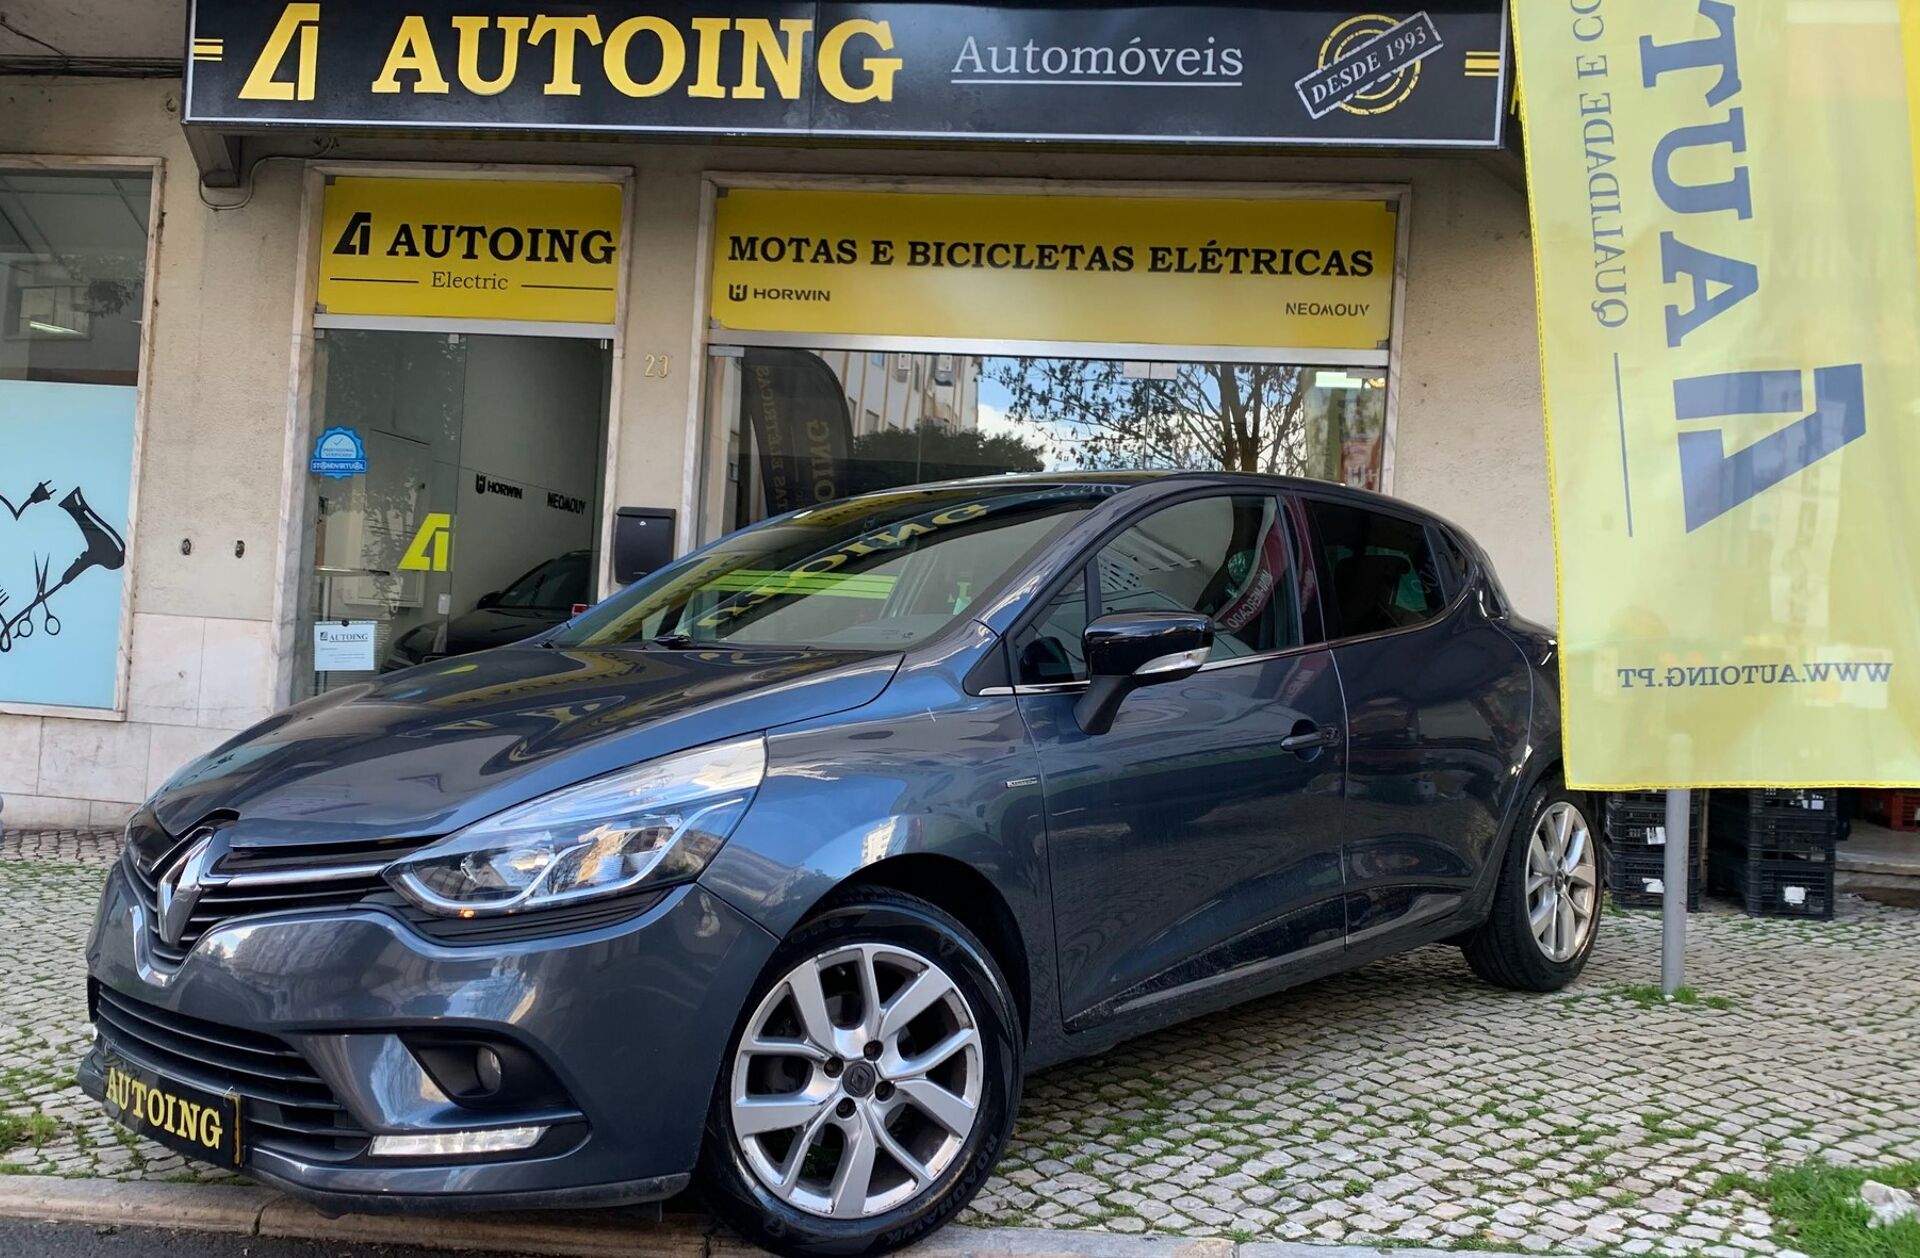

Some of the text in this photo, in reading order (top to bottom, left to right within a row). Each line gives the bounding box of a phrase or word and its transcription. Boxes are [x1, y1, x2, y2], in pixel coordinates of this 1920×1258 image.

[371, 15, 903, 103] AUTOING
[951, 35, 1244, 78] Automóveis
[1311, 26, 1427, 104] DESDE 1993
[386, 223, 617, 265] AUTOING
[728, 235, 1374, 277] MOTAS E BICICLETAS ELÉTRICAS
[431, 271, 509, 291] Electric
[753, 287, 831, 302] HORWIN
[329, 633, 369, 641] AUTOING
[105, 1066, 223, 1151] AUTOING
